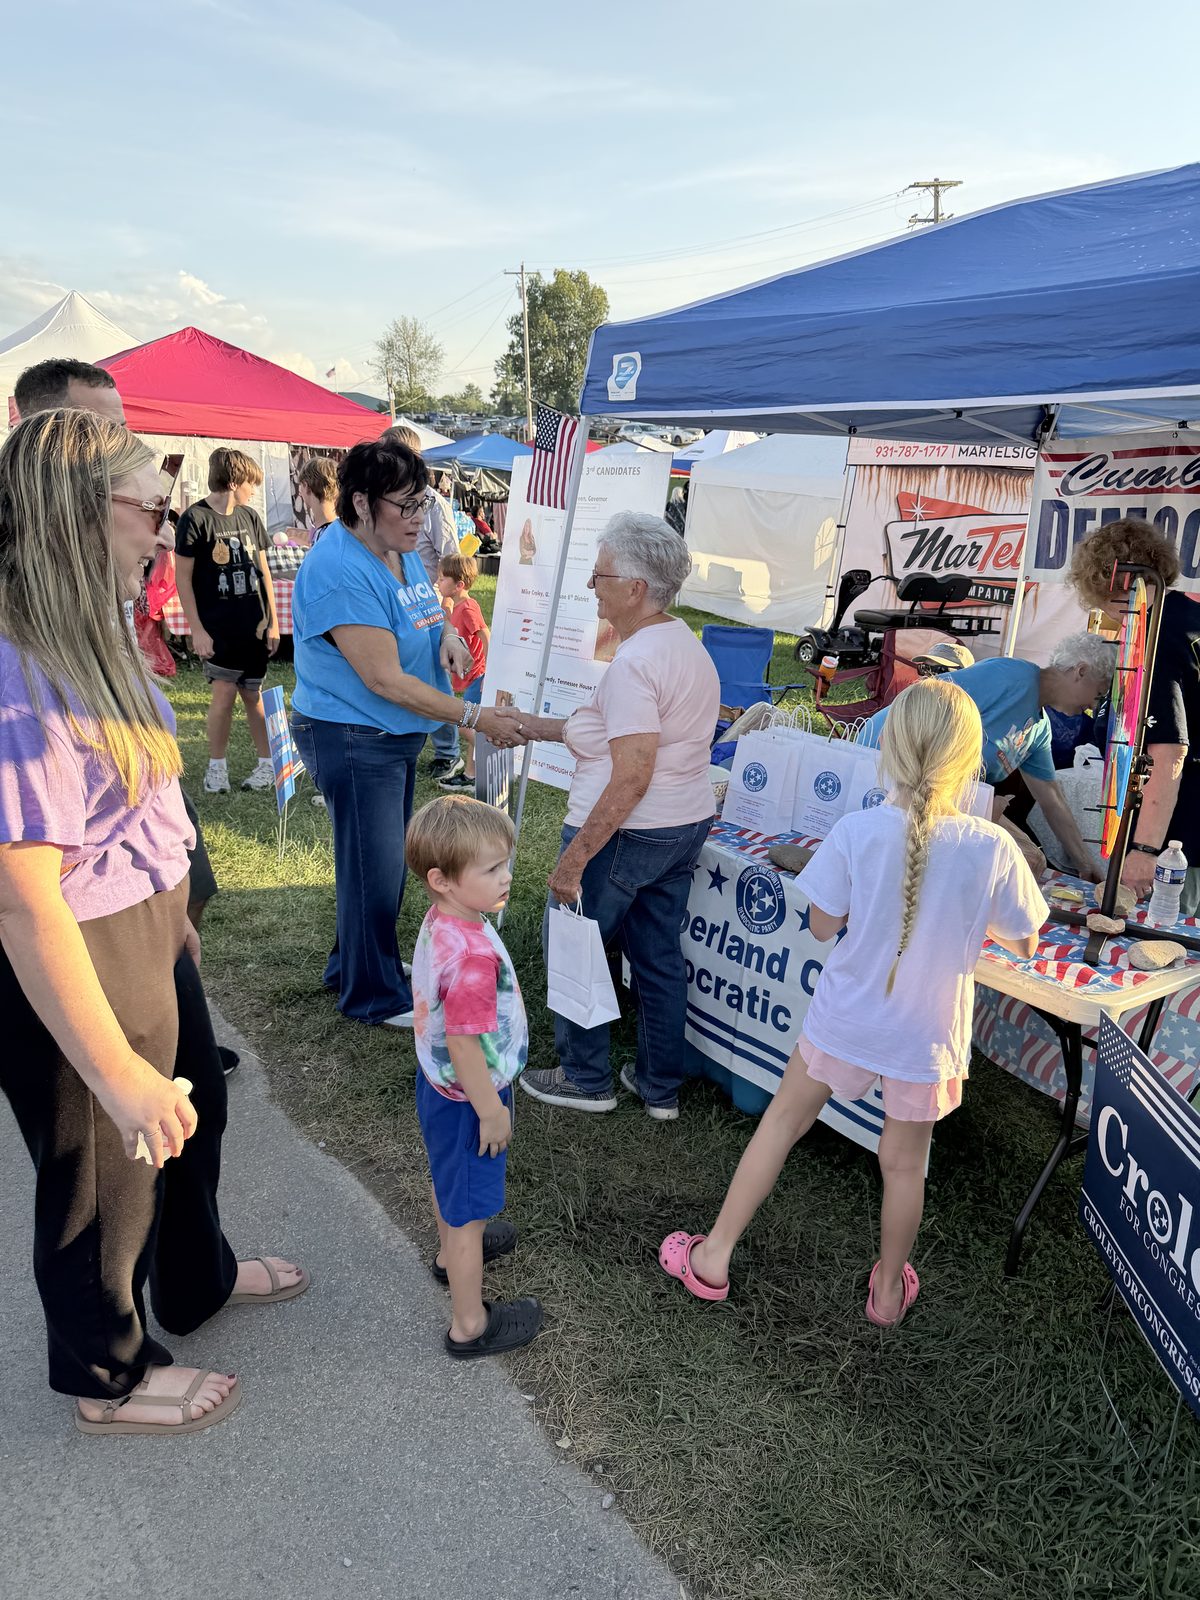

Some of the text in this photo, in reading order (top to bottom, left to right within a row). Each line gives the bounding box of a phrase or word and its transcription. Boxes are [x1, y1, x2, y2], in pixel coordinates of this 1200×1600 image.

[875, 445, 949, 458] 931-787-1717
[596, 466, 641, 476] CANDIDATES
[900, 523, 1028, 573] MarTel
[557, 678, 579, 688] Tennessee
[761, 920, 778, 934] PARTY
[1097, 1105, 1200, 1296] Crol
[1119, 1194, 1140, 1236] FOR
